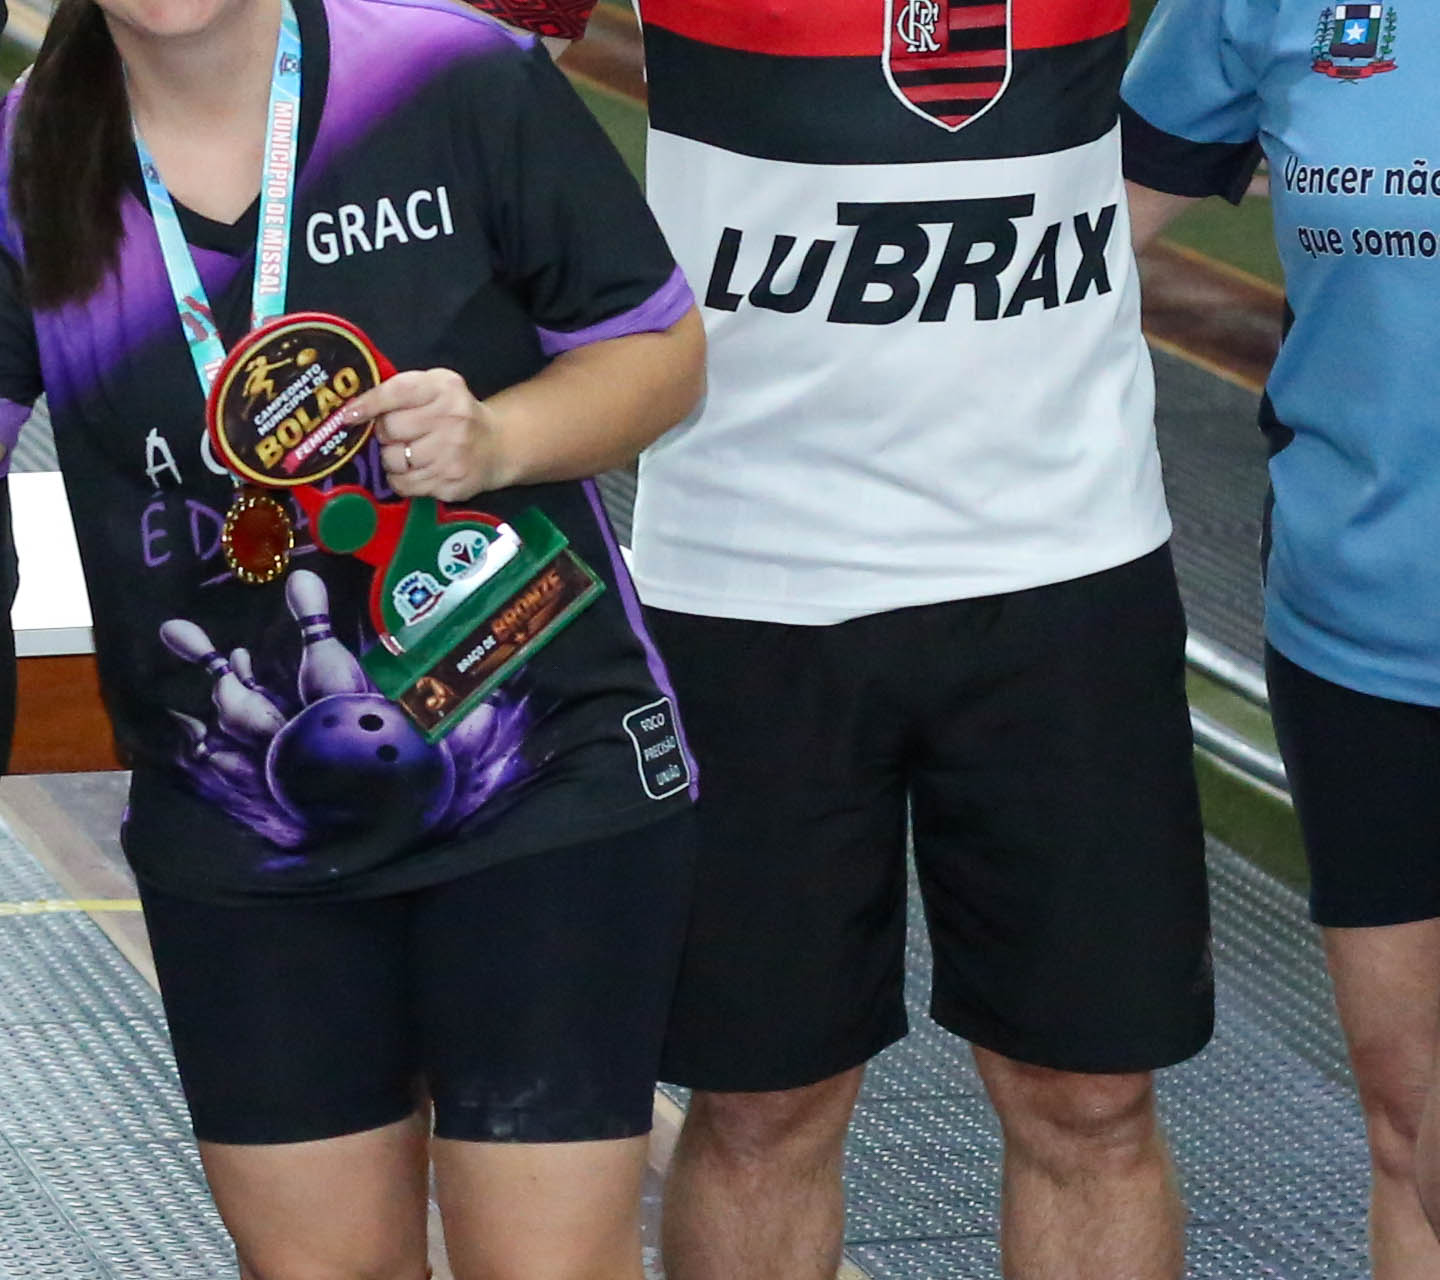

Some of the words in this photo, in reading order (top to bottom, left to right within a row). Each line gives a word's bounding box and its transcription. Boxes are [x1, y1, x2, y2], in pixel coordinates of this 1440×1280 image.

[1283, 155, 1373, 195] Vencer
[264, 201, 286, 226] DE
[305, 185, 455, 265] GRACI
[1298, 226, 1344, 260] que
[258, 227, 285, 296] MISSAL
[704, 193, 1119, 326] LUBRAX
[252, 363, 323, 427] CAMPEONATO
[255, 366, 361, 469] BOLÃO
[256, 386, 314, 437] MUNICIPAL
[313, 370, 330, 387] DE
[145, 427, 183, 489] A
[295, 407, 348, 461] FEMININ
